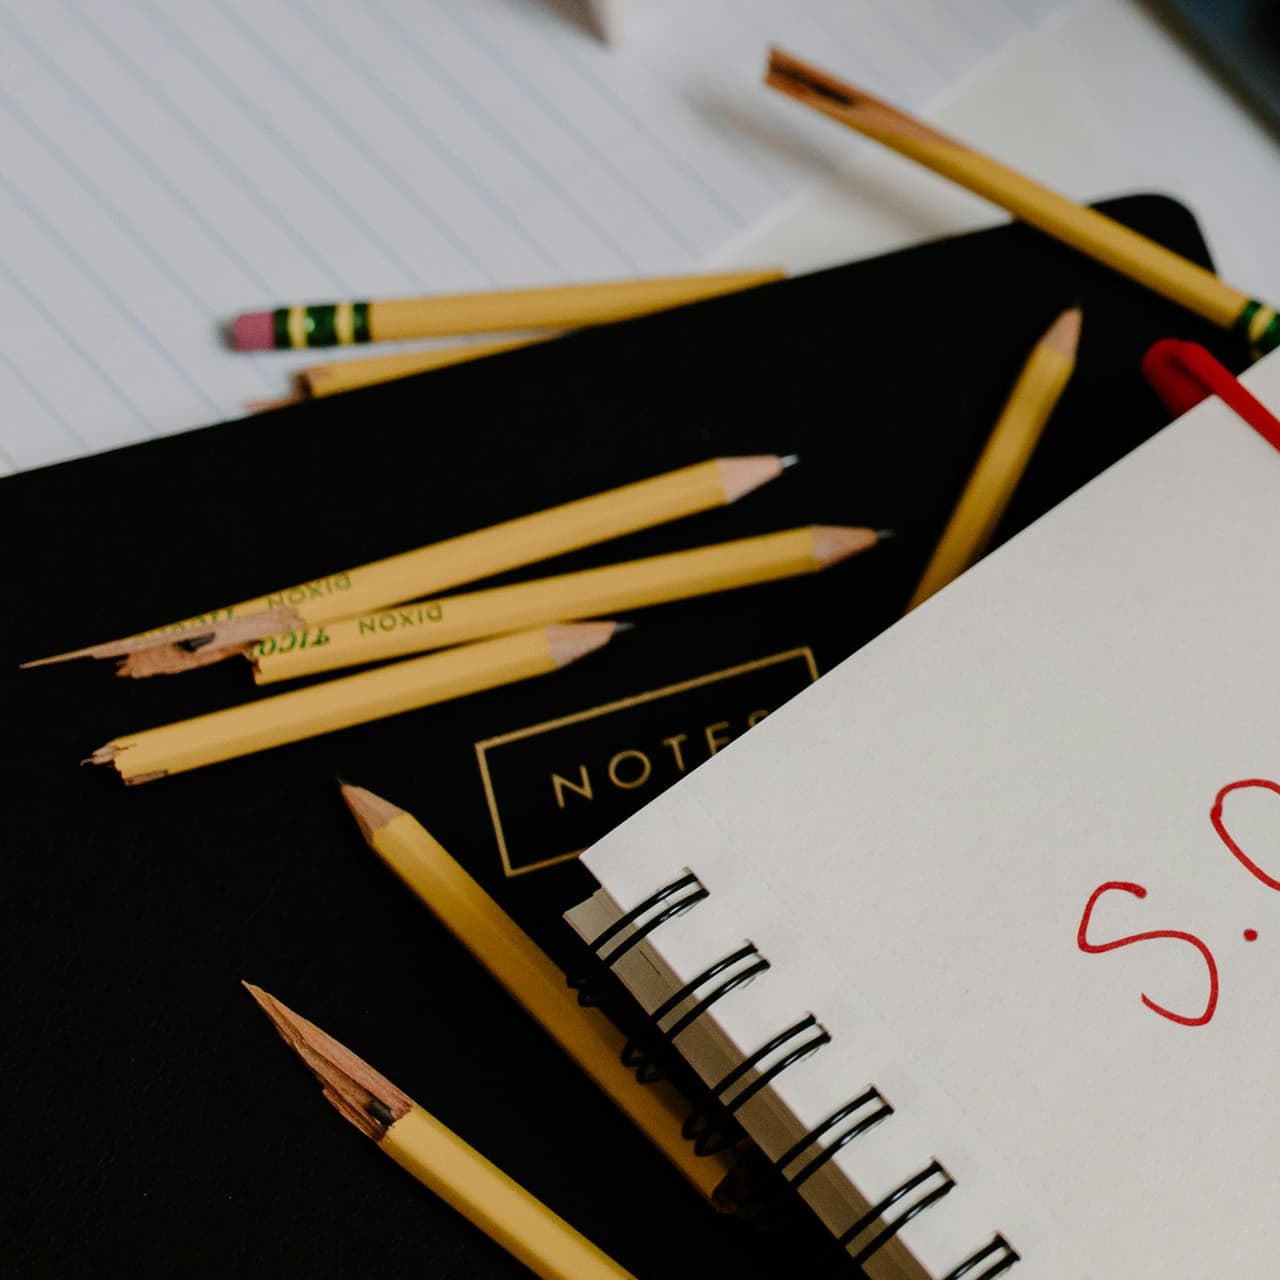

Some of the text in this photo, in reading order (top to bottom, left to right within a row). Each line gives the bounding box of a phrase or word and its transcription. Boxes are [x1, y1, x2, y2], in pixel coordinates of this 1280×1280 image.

[268, 573, 353, 610] DIXON
[247, 603, 444, 658] DIXON TICO
